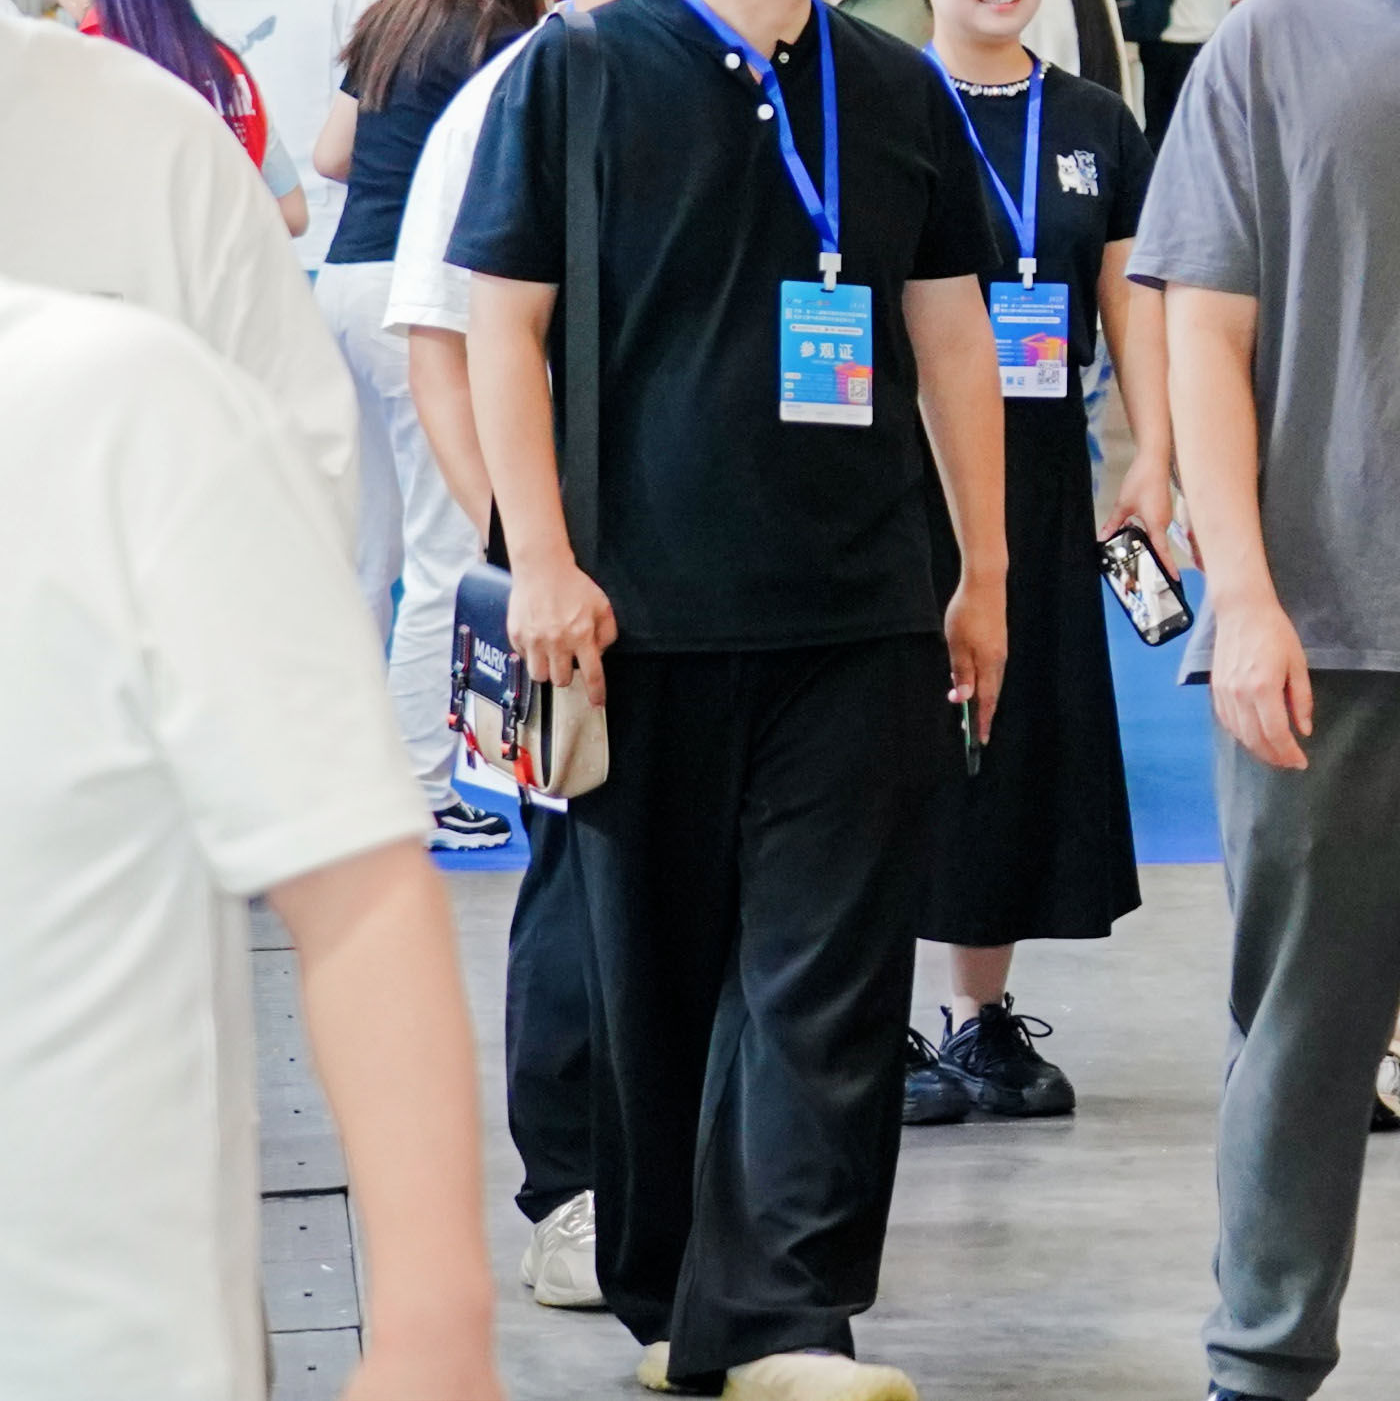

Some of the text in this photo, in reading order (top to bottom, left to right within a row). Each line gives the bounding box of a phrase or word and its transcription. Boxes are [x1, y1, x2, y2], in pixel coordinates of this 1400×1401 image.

[800, 340, 854, 360] 参观证
[475, 637, 508, 674] MARK
